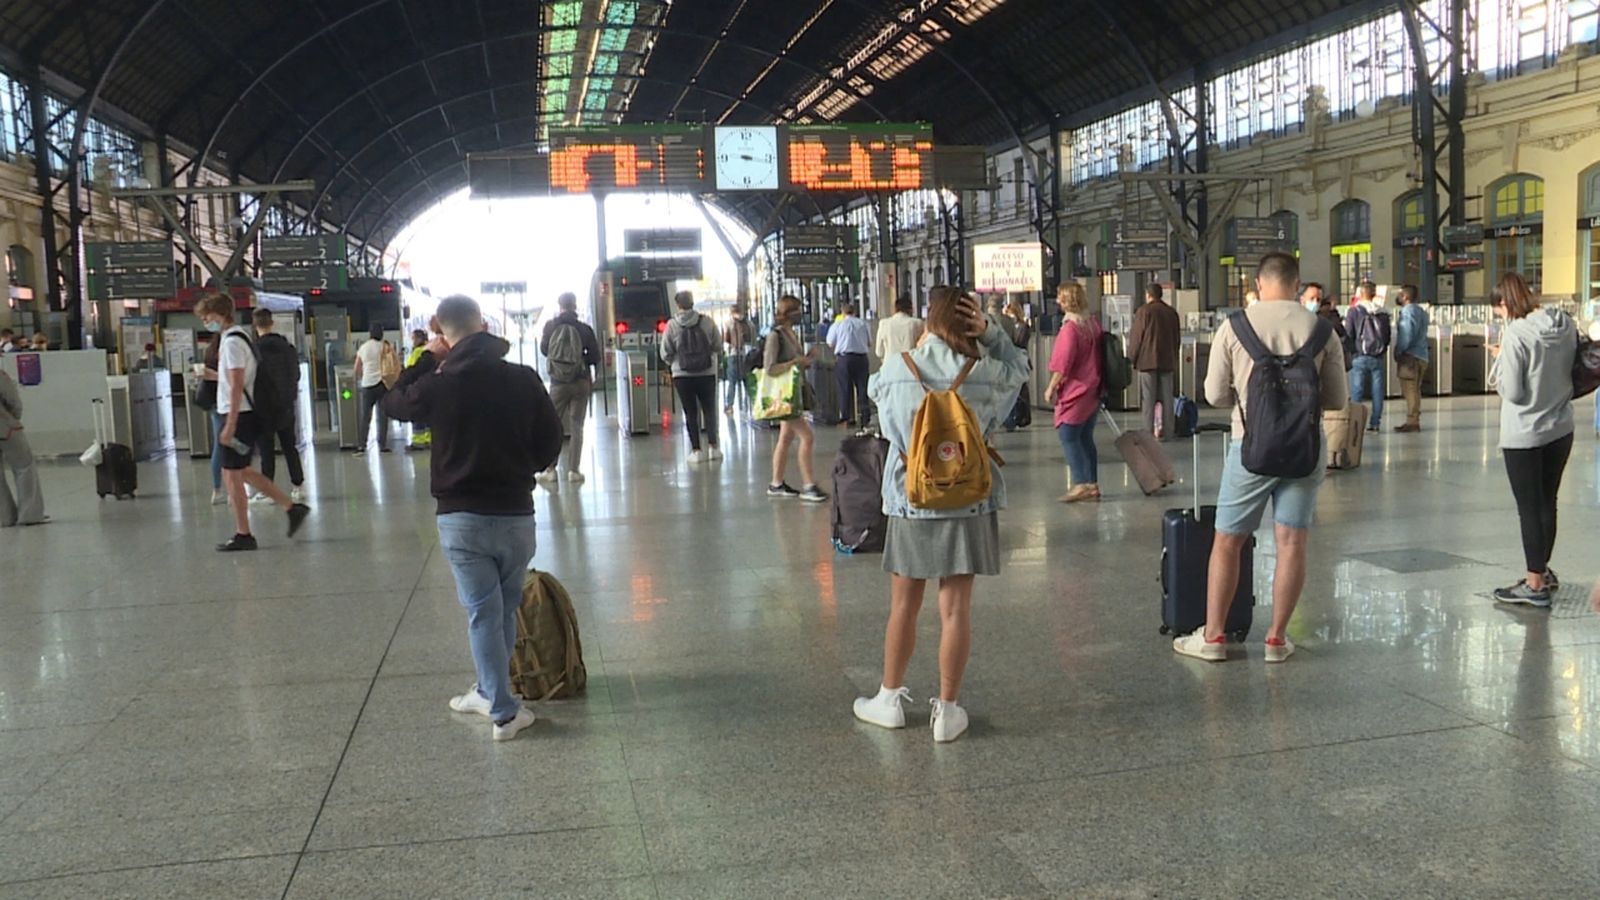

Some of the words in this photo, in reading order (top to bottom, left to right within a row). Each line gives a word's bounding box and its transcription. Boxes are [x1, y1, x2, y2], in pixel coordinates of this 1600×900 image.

[741, 132, 752, 140] 12
[721, 154, 728, 162] 9
[765, 153, 772, 163] 3
[744, 176, 751, 184] 6
[319, 248, 327, 259] 2
[992, 252, 1024, 260] ACCESO
[981, 261, 1011, 269] TRENES
[320, 279, 328, 289] 2
[982, 277, 1034, 286] REGIONALES
